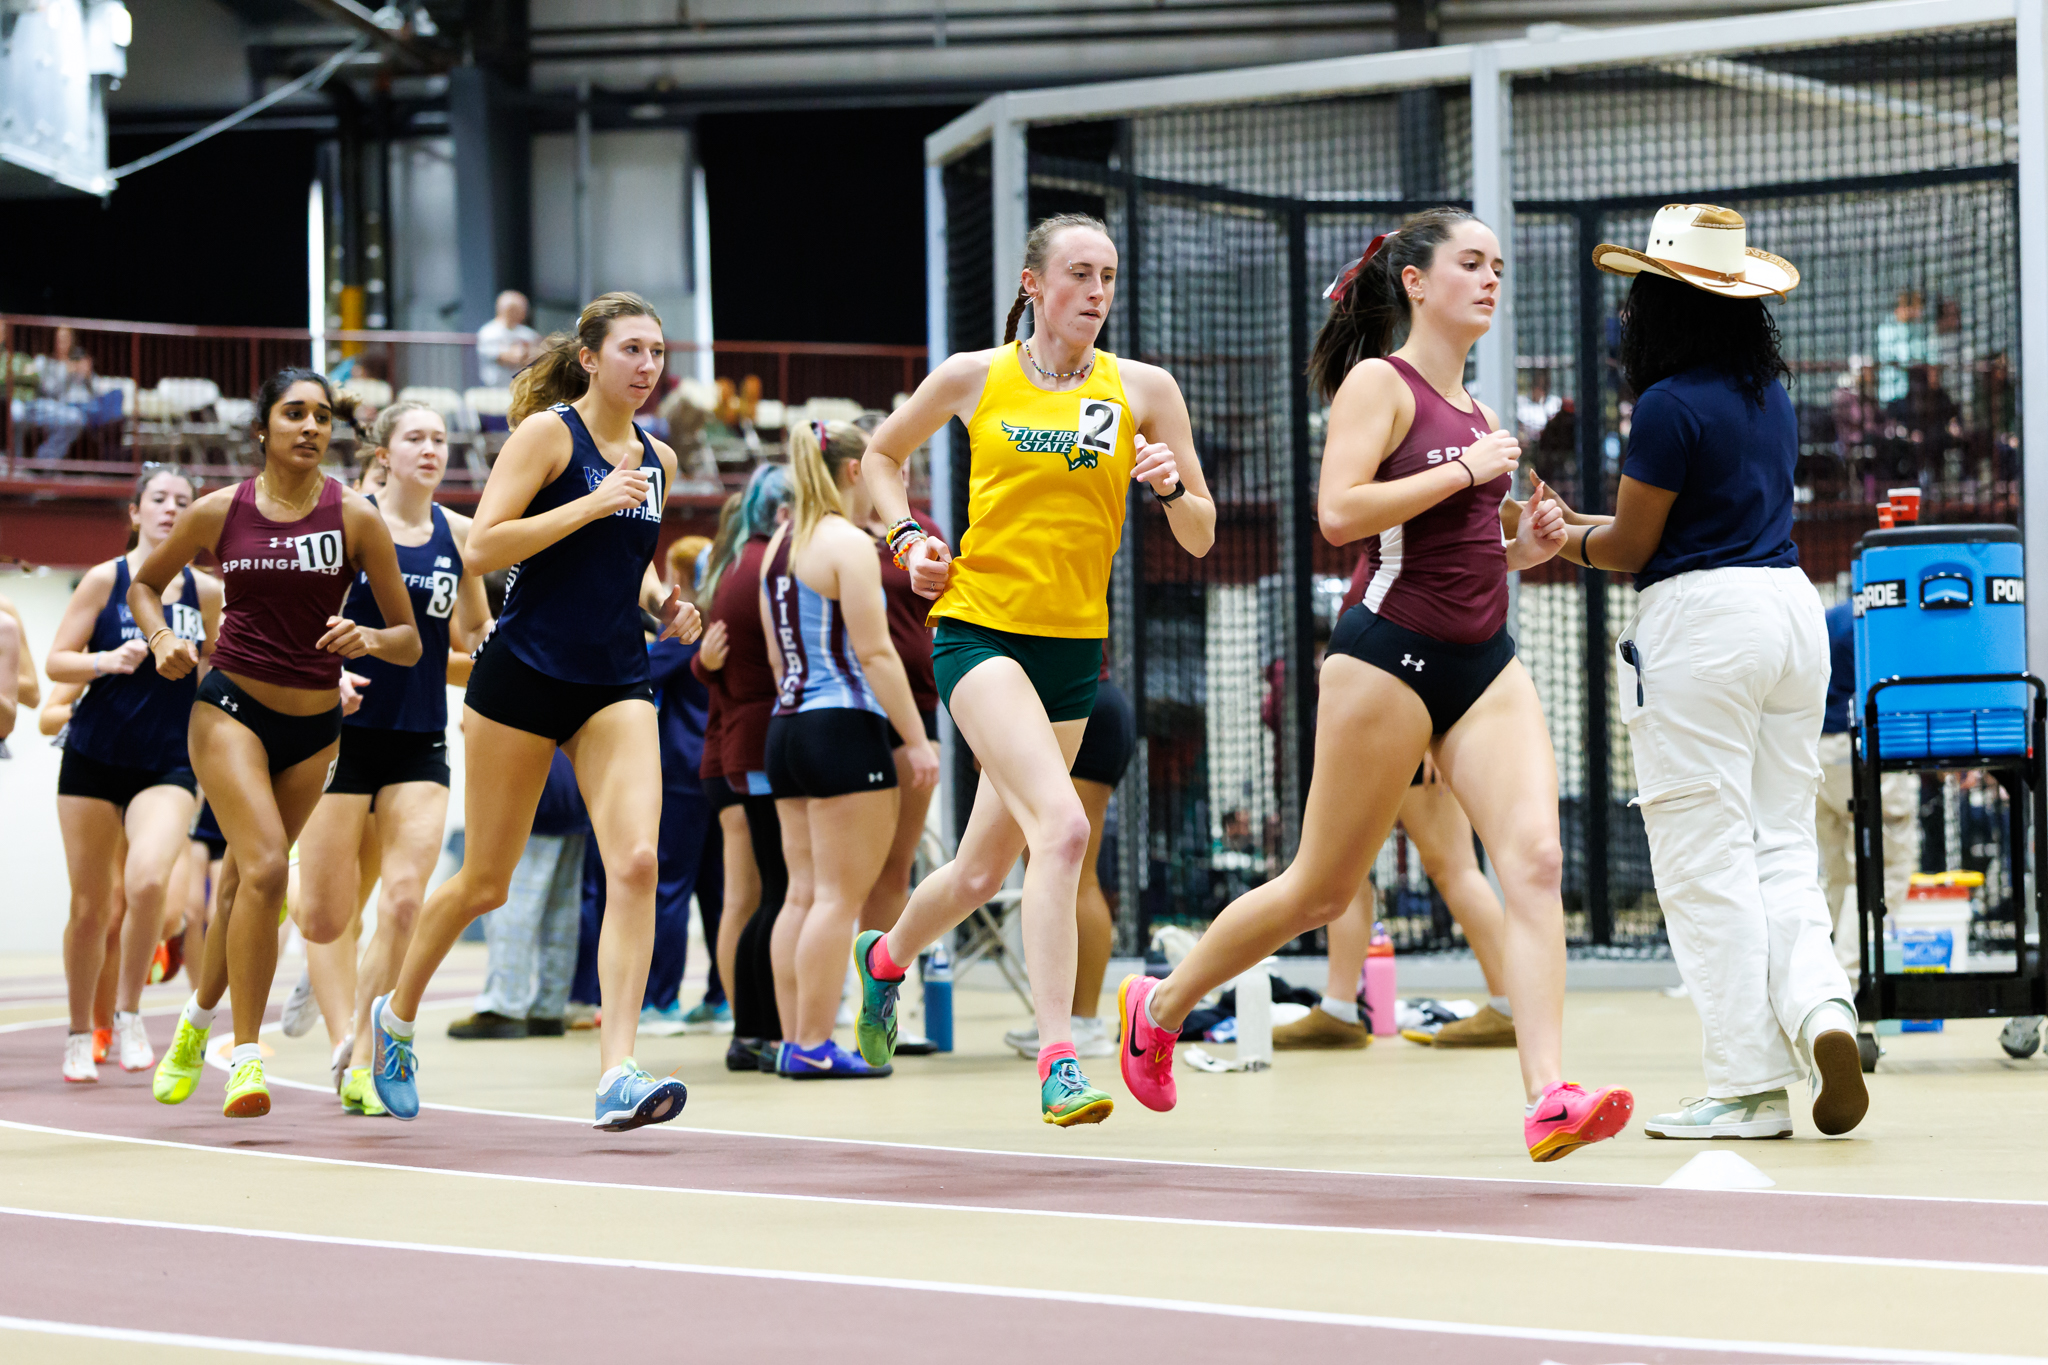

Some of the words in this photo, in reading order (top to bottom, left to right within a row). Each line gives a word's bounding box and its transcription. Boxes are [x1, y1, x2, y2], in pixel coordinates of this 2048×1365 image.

[1082, 403, 1114, 451] 2
[1017, 441, 1074, 453] STATE
[300, 533, 337, 568] 10
[434, 576, 453, 614] 3
